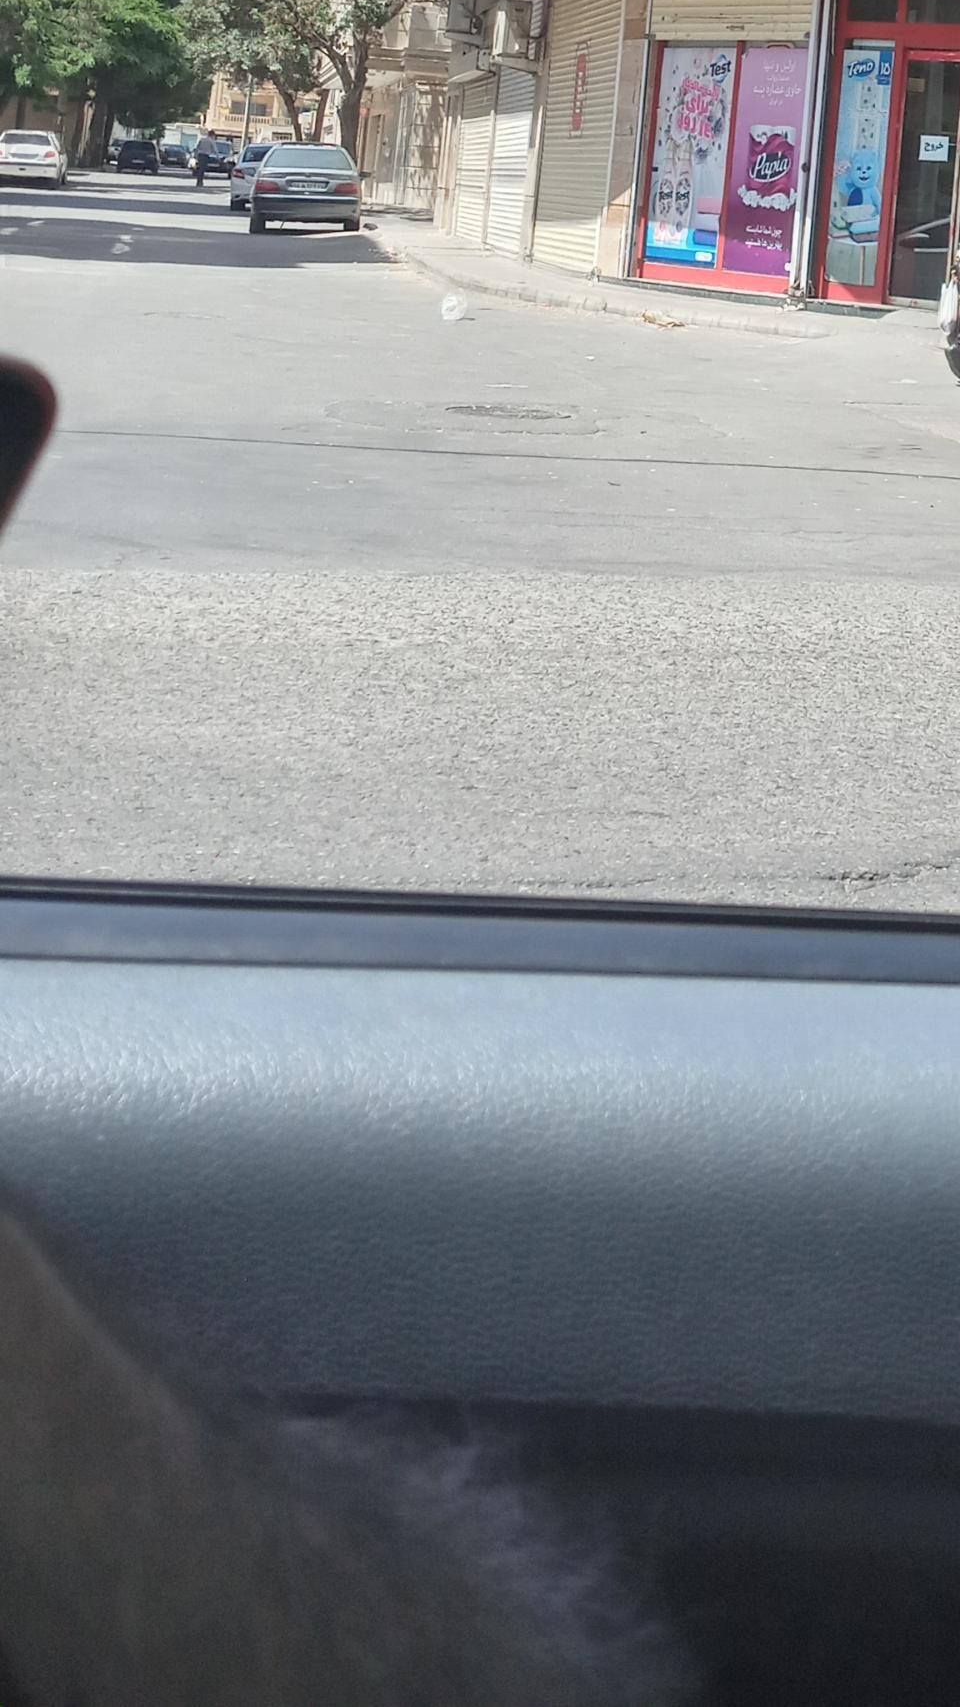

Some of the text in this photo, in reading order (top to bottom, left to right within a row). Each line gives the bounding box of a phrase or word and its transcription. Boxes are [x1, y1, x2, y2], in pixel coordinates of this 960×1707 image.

[710, 60, 731, 77] Test
[924, 141, 944, 152] خروج
[753, 152, 788, 181] Papia
